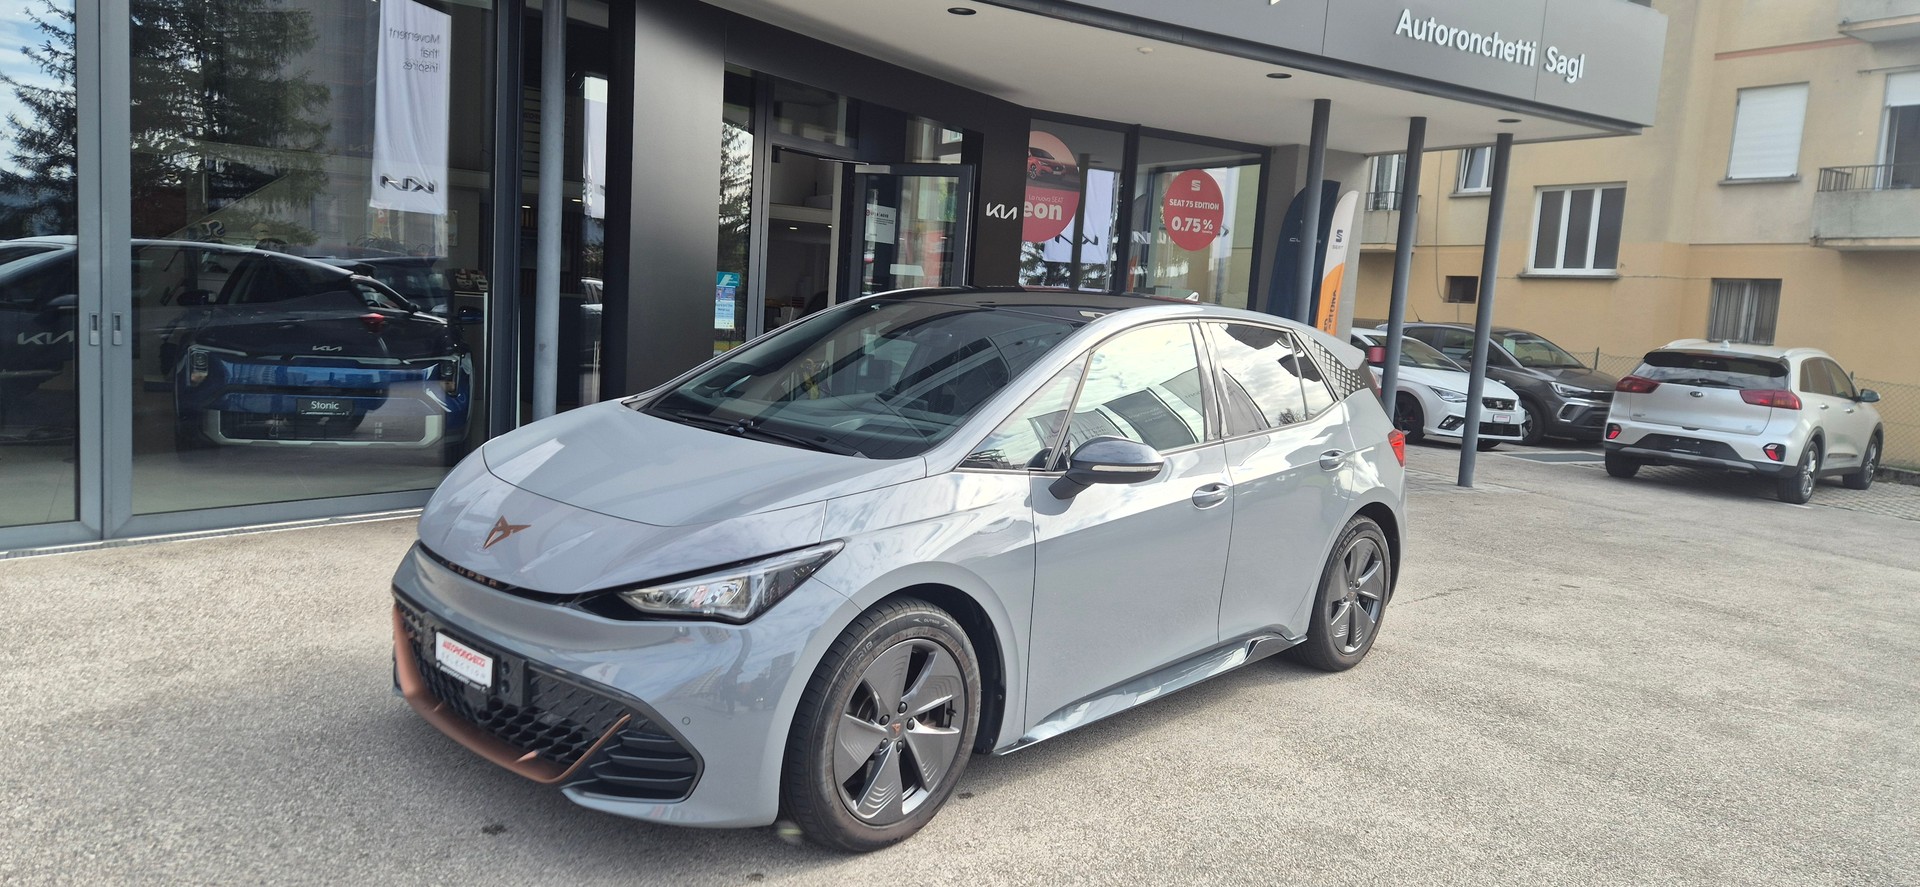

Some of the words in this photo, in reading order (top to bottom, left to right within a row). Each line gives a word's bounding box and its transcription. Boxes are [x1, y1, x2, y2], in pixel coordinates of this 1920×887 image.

[1395, 8, 1537, 67] Autoronchetti
[1545, 46, 1585, 83] Sagl
[1051, 196, 1064, 204] SEAT
[1169, 198, 1185, 207] SEAT
[1194, 201, 1220, 211] EDITION
[985, 202, 1018, 220] KIA
[1023, 201, 1063, 221] eon
[311, 400, 340, 410] Stonic
[448, 562, 497, 588] CUPRA
